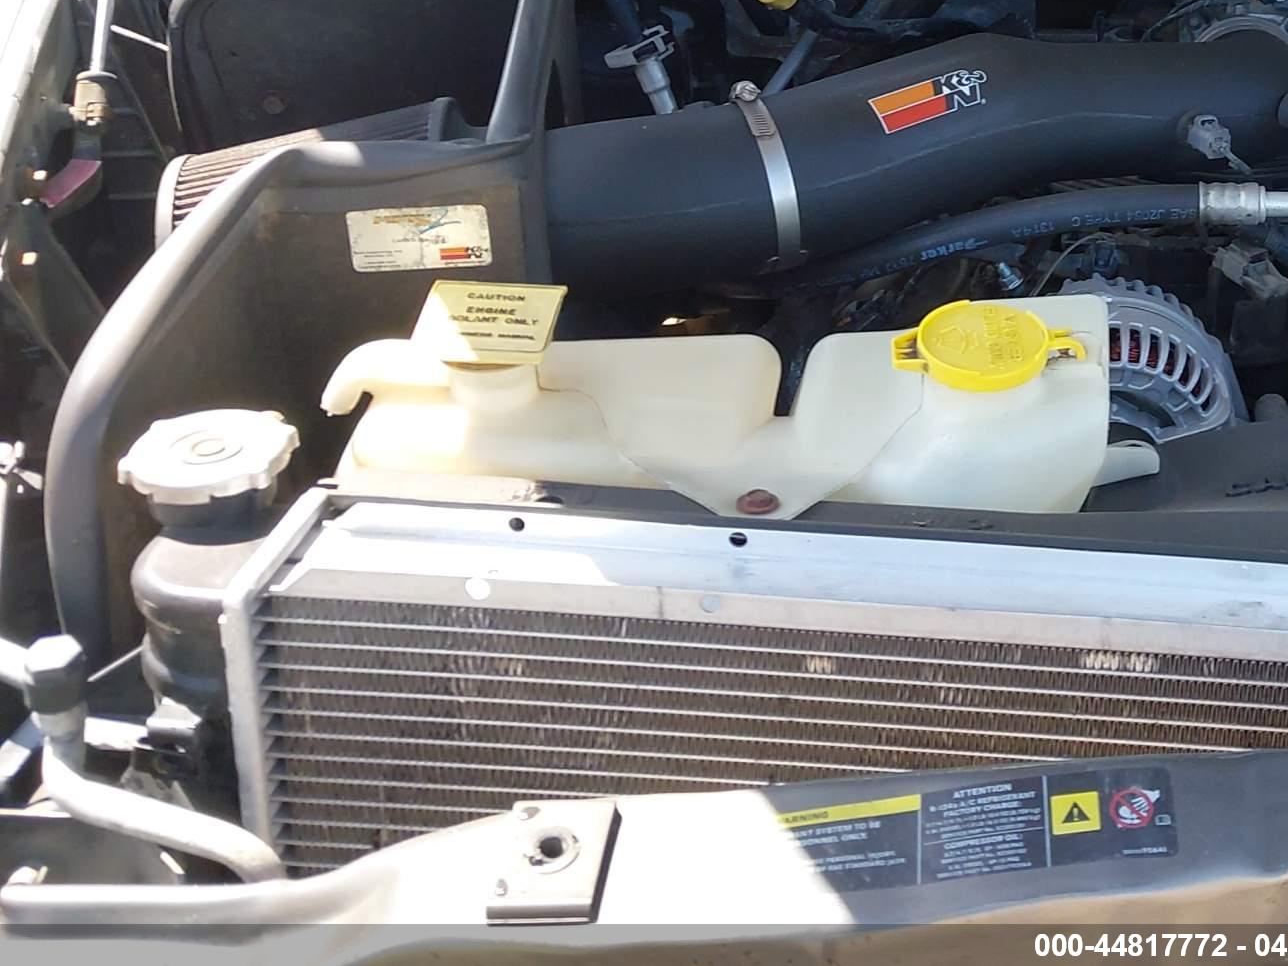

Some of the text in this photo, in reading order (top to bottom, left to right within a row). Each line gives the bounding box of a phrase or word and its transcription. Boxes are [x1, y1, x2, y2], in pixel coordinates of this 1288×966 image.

[934, 69, 987, 110] K&N
[467, 292, 525, 301] CAUTION
[466, 306, 517, 315] ENGINE
[504, 317, 539, 326] ONLY
[952, 783, 1012, 799] ATTENTION
[977, 791, 1036, 804] REFRIGERANT
[943, 806, 981, 817] FACTORY
[943, 835, 1004, 849] COMPRESSOR
